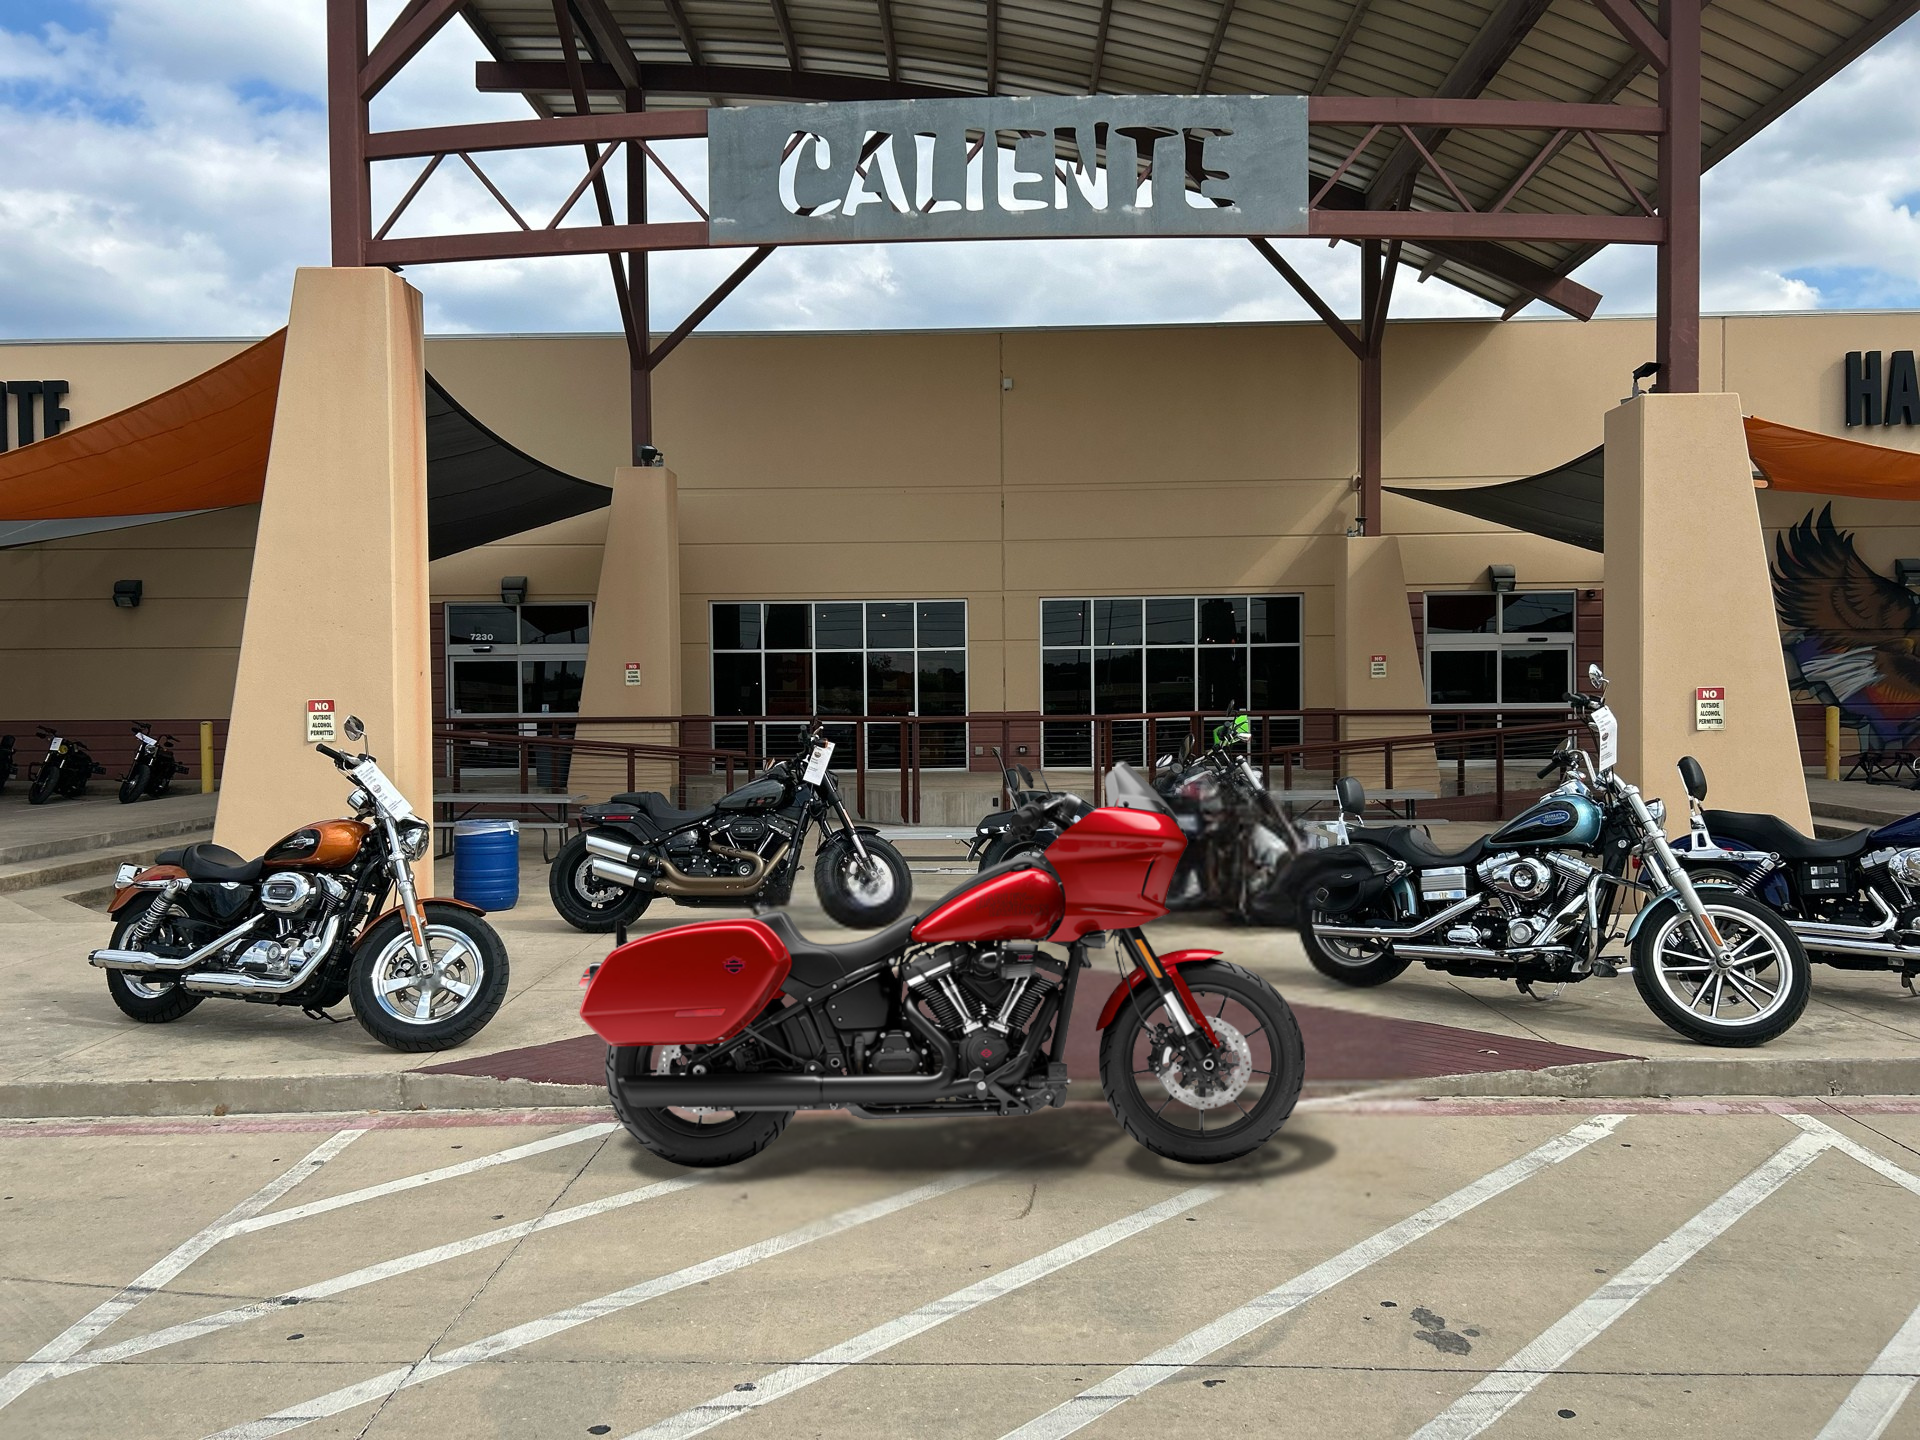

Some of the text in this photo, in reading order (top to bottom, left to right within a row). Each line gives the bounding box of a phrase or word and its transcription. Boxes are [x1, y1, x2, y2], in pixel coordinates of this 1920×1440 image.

[778, 121, 1236, 218] CALIENTE
[1845, 350, 1920, 426] HA
[470, 633, 494, 641] 7230
[1702, 690, 1718, 699] NO
[314, 702, 330, 711] NO
